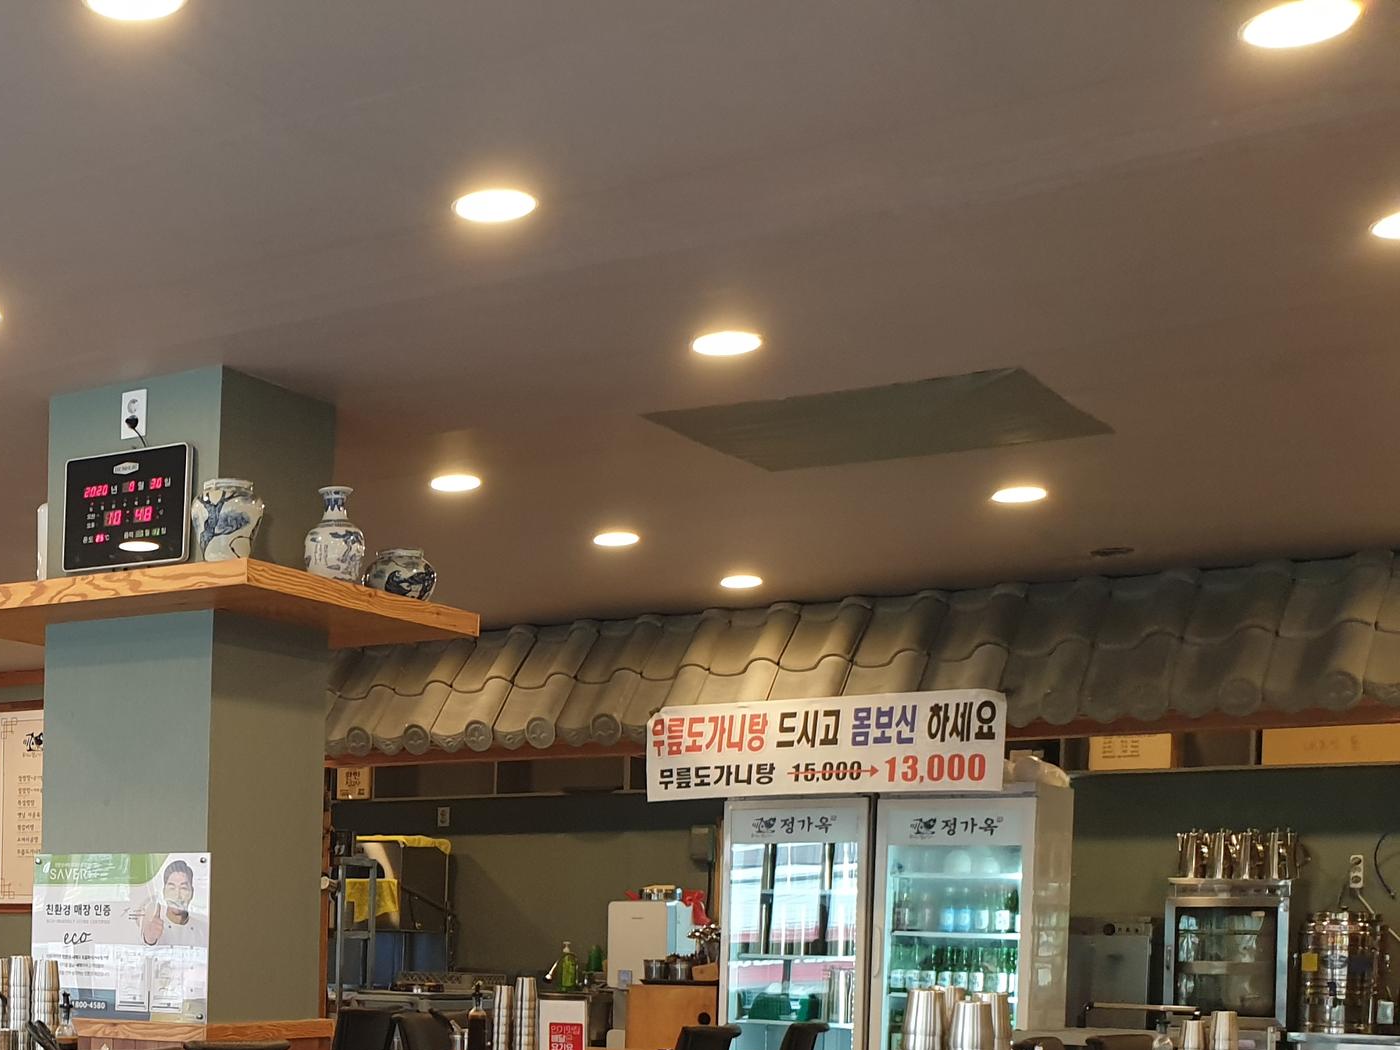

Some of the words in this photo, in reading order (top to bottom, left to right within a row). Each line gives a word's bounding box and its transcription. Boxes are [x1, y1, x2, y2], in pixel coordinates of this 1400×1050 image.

[651, 712, 768, 757] 무릎도가니탕
[775, 709, 841, 748] 드시고
[850, 705, 917, 746] 몸보신
[926, 700, 997, 743] 하세요
[659, 762, 775, 790] 무릎도가니탕
[791, 760, 862, 783] 15,000
[884, 752, 987, 784] 13,000
[780, 815, 833, 834] 정가옥
[941, 817, 998, 836] 정가옥
[46, 904, 71, 916] 친환경
[74, 904, 91, 917] 매장
[94, 904, 111, 917] 인증
[64, 932, 93, 945] eco
